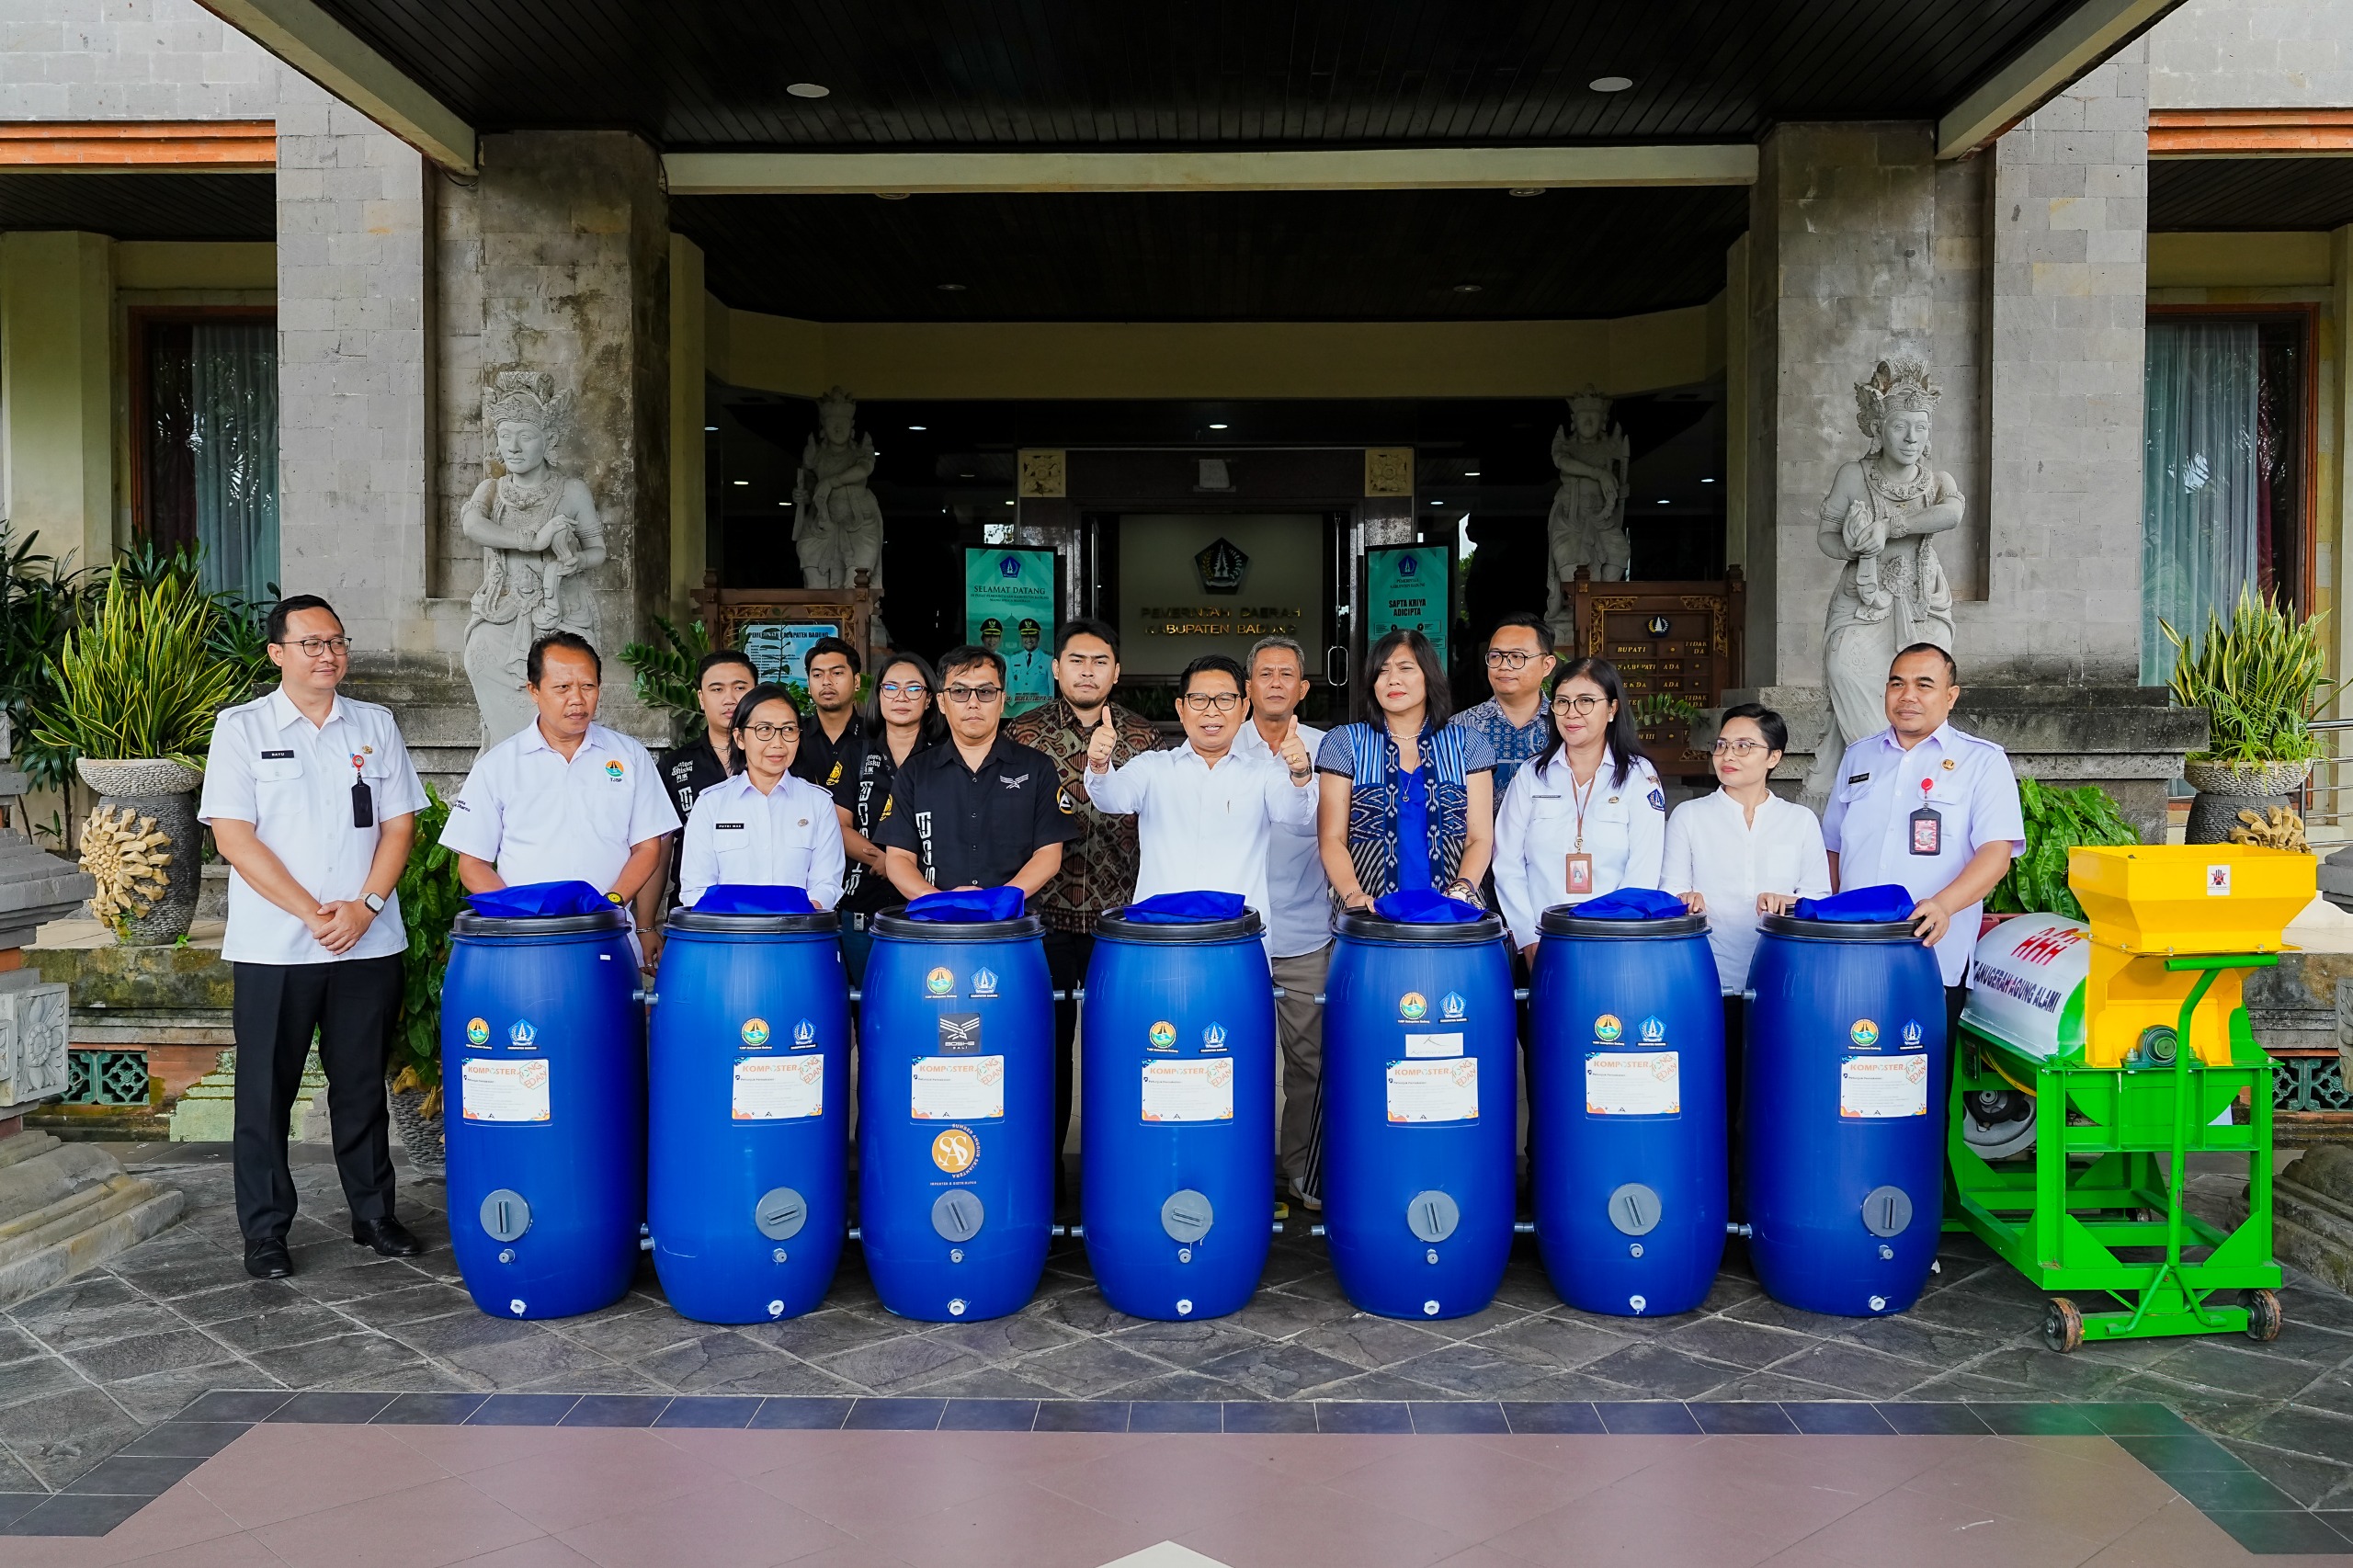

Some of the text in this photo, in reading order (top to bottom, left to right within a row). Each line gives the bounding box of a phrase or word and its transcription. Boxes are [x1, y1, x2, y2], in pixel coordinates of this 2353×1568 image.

[974, 585, 1010, 594] SELAMAT
[1388, 598, 1427, 608] SAPTA KRIYA
[1141, 608, 1301, 618] PEMERINTAH DAERAH
[1393, 608, 1422, 617] ADICIPTA
[1145, 624, 1297, 634] KABUPATEN BADUNG
[1974, 962, 2014, 994] ANUGERAH
[2008, 976, 2038, 1004] AGUNG
[2032, 986, 2062, 1014] ALAMI
[468, 1066, 517, 1075] KOMPOSTER
[743, 1064, 798, 1073] KOMPOSTER
[1394, 1068, 1449, 1076] KOMPOSTER
[1655, 1063, 1677, 1081] EDAN
[1909, 1065, 1927, 1084] EDAN
[524, 1071, 547, 1089] EDAN
[803, 1066, 823, 1085] EDAN
[981, 1067, 1003, 1085] EDAN
[1211, 1069, 1232, 1087] EDAN
[1456, 1068, 1476, 1087] EDAN
[951, 1123, 973, 1135] SUMBER
